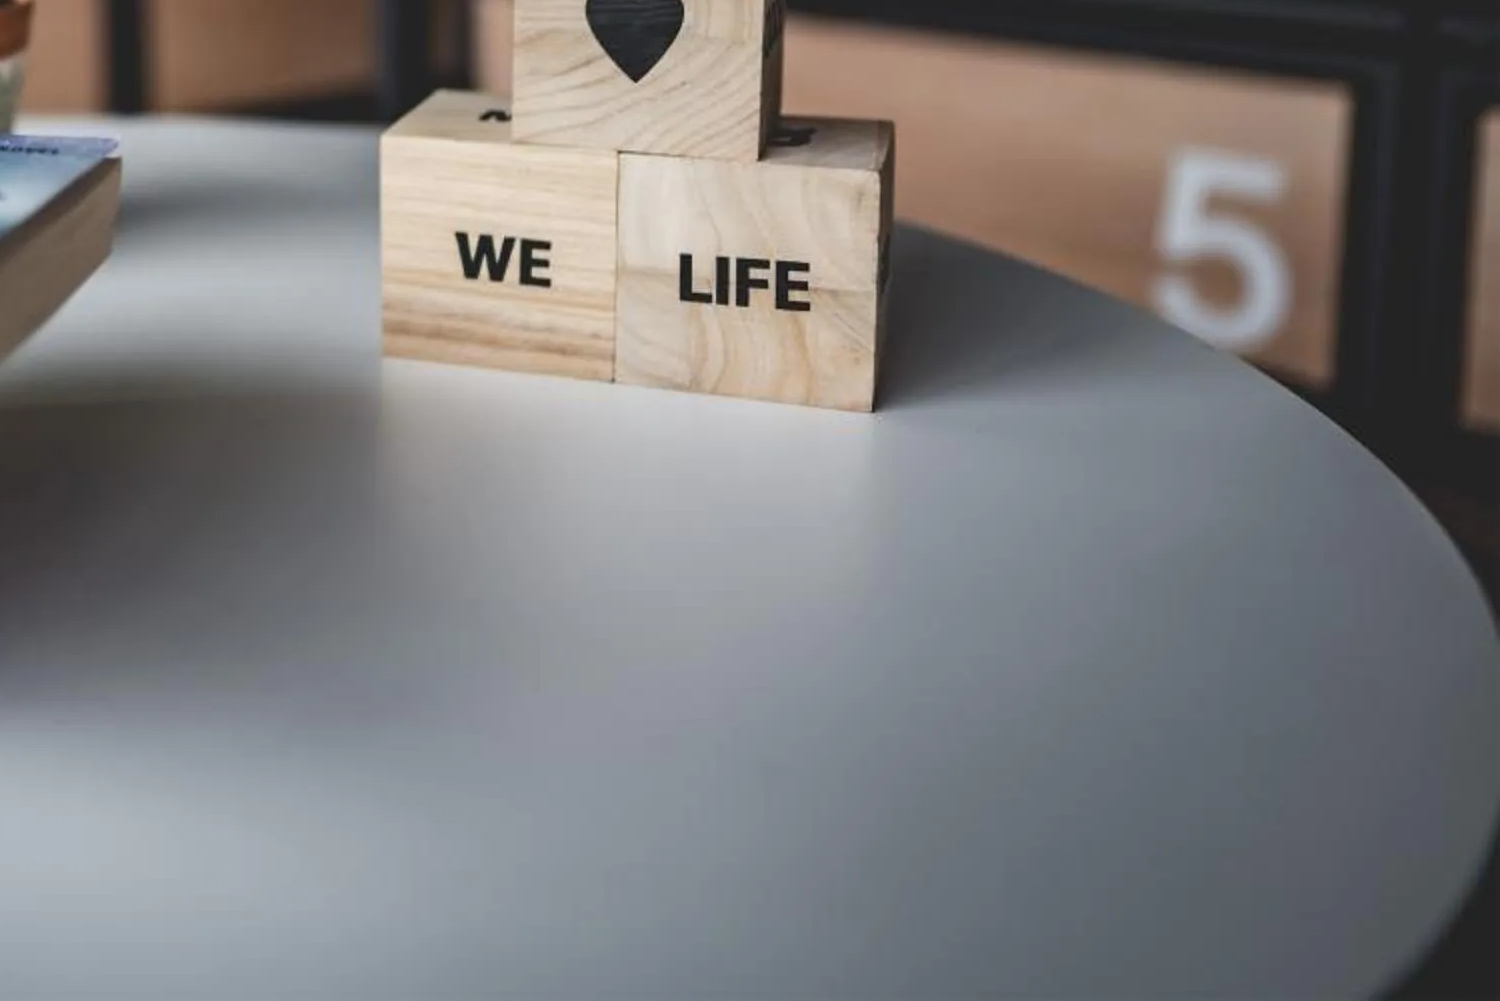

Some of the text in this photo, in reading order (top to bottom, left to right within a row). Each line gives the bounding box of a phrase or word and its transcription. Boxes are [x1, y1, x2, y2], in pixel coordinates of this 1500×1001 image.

[455, 231, 552, 288] WE
[1155, 152, 1291, 351] 5
[678, 253, 811, 312] LIFE
